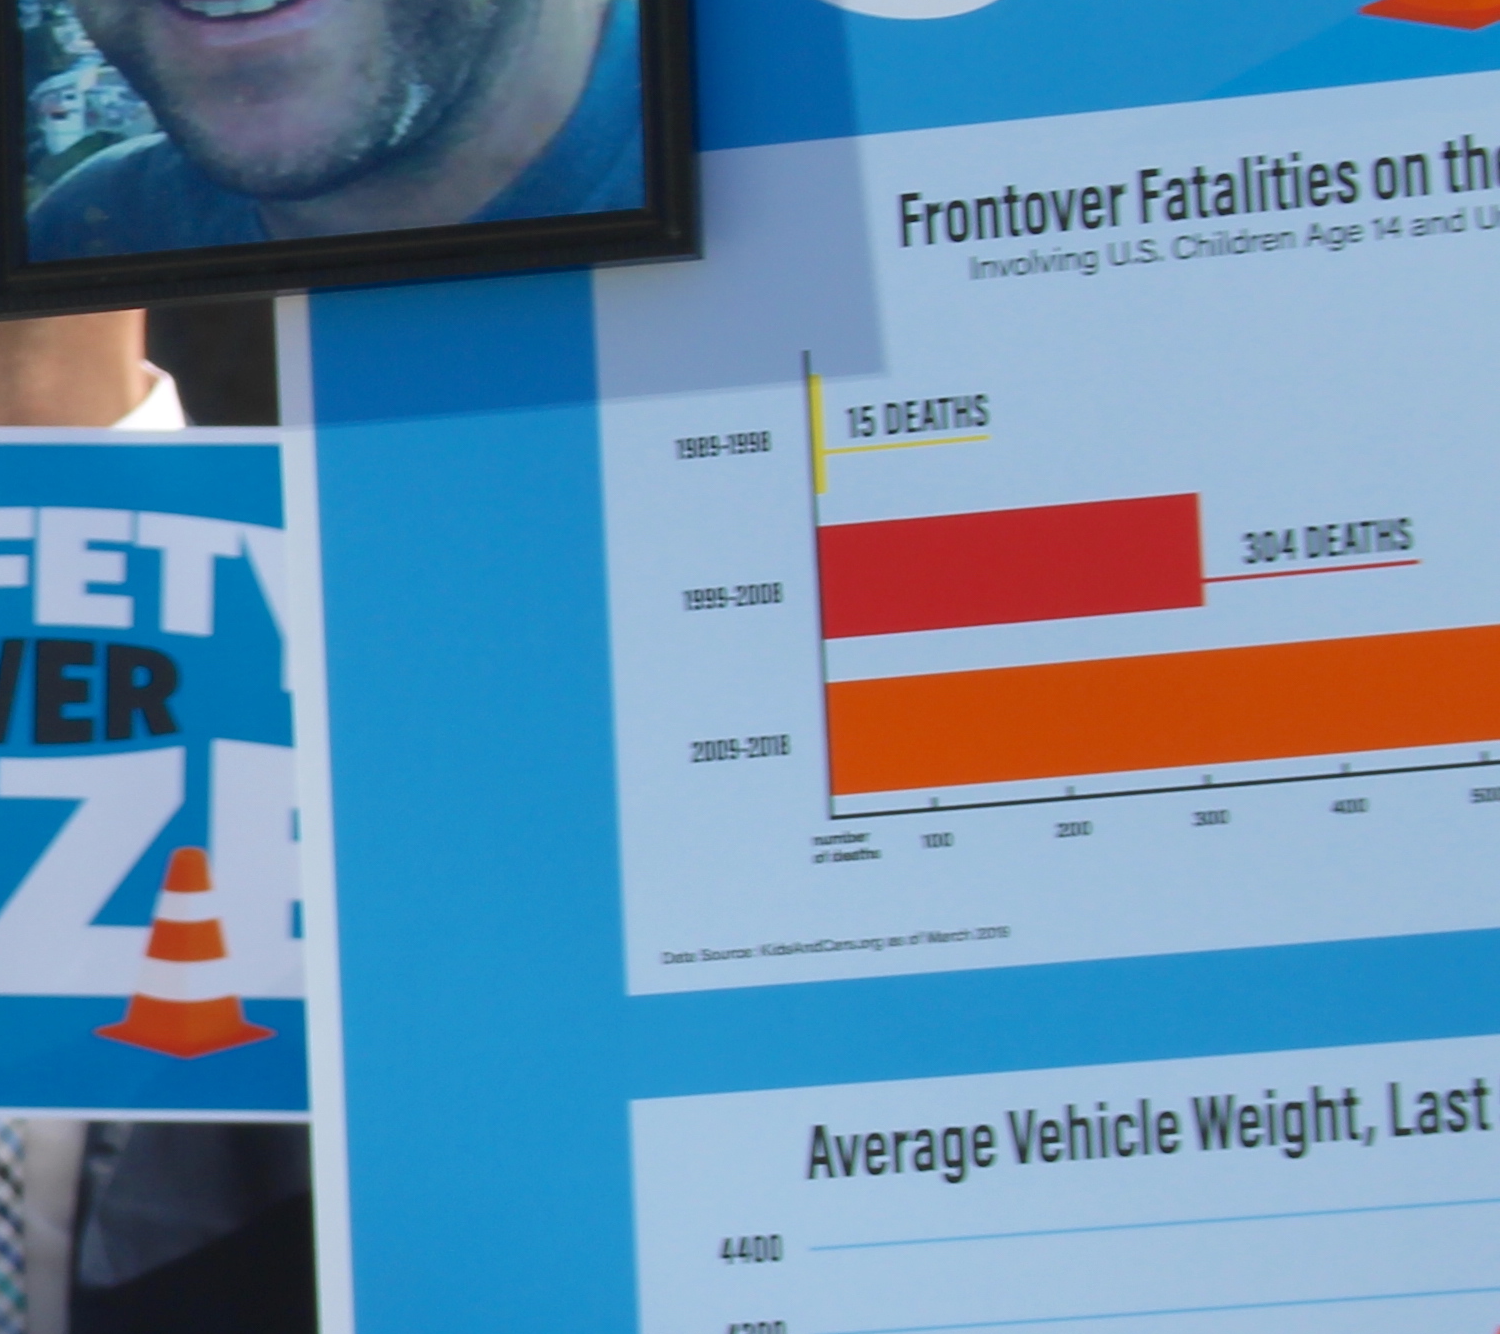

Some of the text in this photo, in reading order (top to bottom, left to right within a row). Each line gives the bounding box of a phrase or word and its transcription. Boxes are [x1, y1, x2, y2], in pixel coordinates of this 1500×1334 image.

[900, 133, 1500, 248] Frontover Fatalities on th
[969, 246, 1099, 280] Involving
[1106, 236, 1165, 266] U.S.
[1171, 223, 1297, 260] Children
[1304, 222, 1365, 252] Age
[1370, 216, 1402, 240] 14
[1409, 207, 1467, 237] and
[846, 394, 991, 438] 15 DEATHS
[675, 431, 773, 460] 1989-1998
[1241, 518, 1414, 566] 304 DEATHS
[682, 582, 784, 612] 1999-2008
[690, 734, 792, 763] 2009-2018
[921, 832, 956, 849] 100
[1054, 820, 1093, 839] 200
[1192, 809, 1231, 828] 300
[1330, 797, 1369, 816] 400
[806, 1076, 1495, 1184] Average Vehicle Weight, Last
[720, 1233, 784, 1265] 4400
